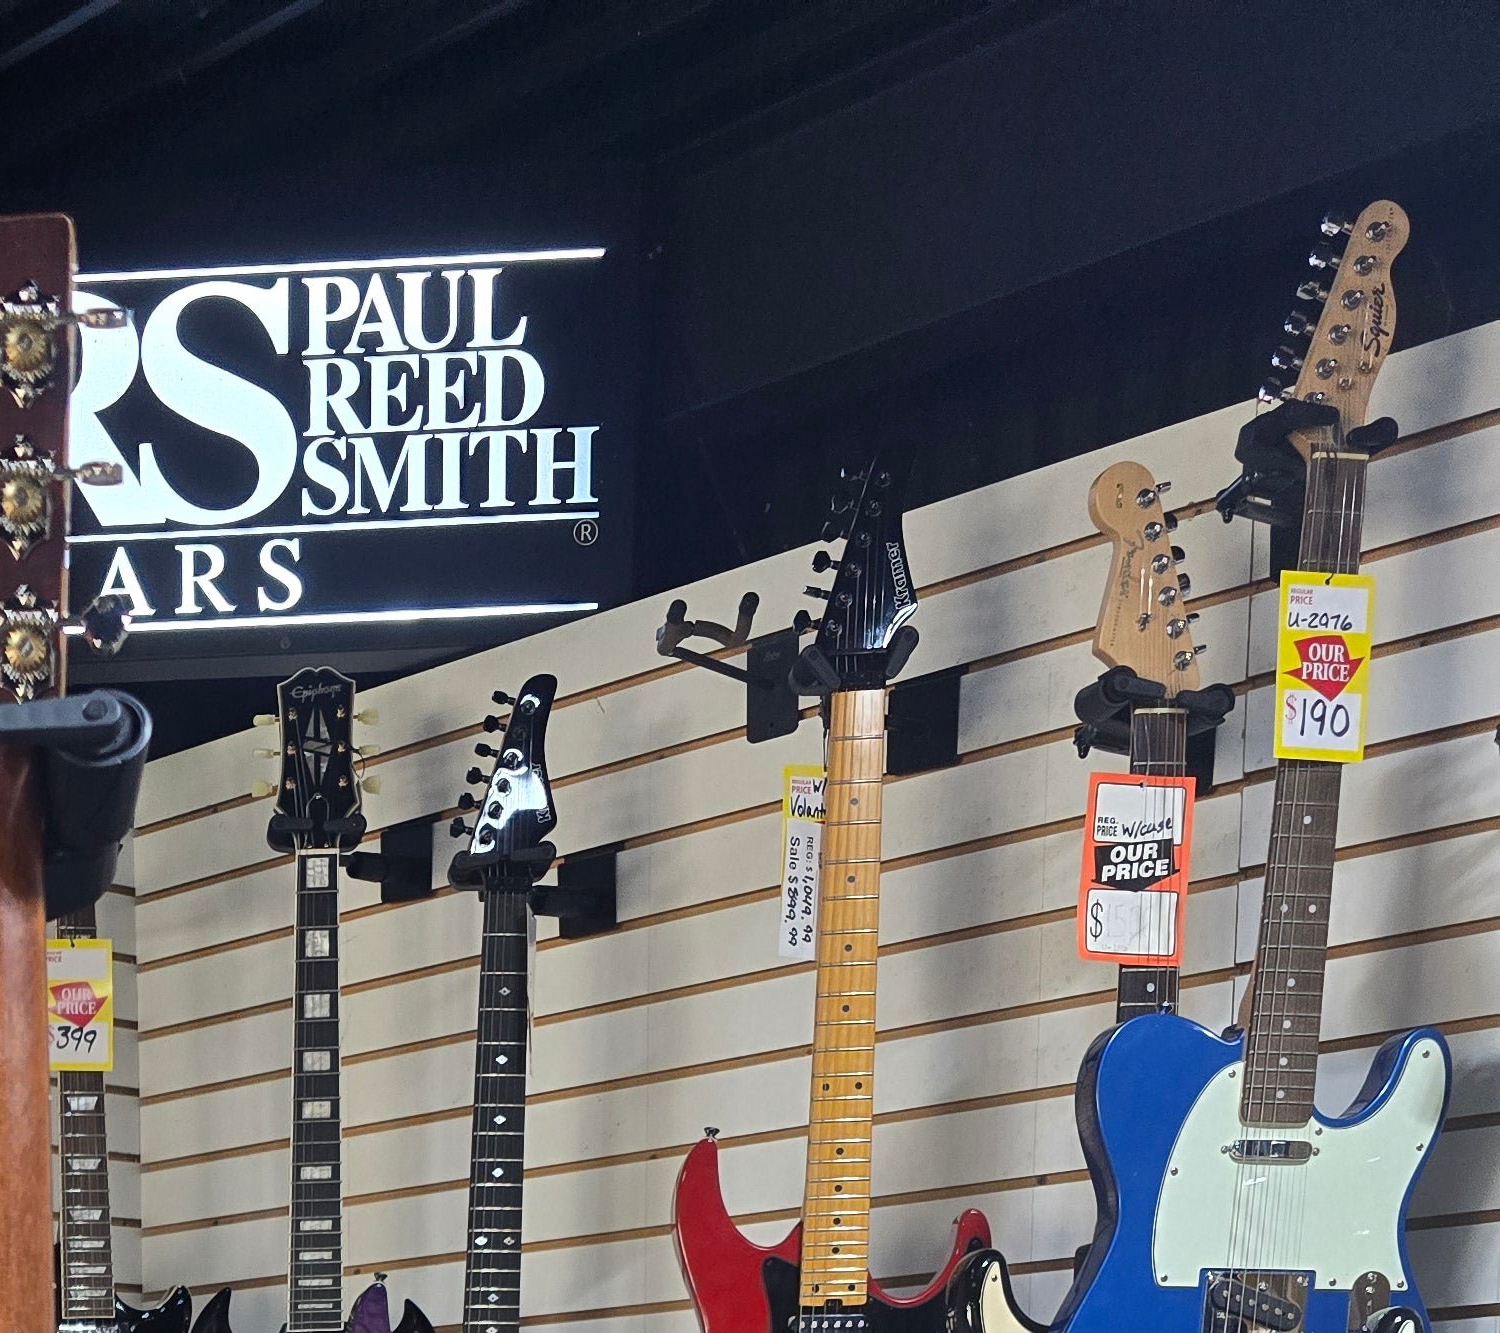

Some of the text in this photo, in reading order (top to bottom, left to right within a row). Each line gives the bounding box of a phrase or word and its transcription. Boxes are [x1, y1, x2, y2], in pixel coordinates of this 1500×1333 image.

[302, 268, 528, 357] PAUL
[1362, 282, 1386, 358] Squier
[303, 347, 546, 437] REED
[301, 426, 601, 519] SMITH
[1290, 595, 1313, 606] PRICE
[1307, 642, 1346, 663] OUR
[1300, 661, 1351, 684] PRICE
[790, 785, 813, 796] PRICE
[1096, 825, 1119, 837] PRICE
[1109, 842, 1159, 865] OUR
[1100, 858, 1171, 883] PRICE
[60, 986, 91, 1001] OUR
[56, 1000, 98, 1016] PRICE
